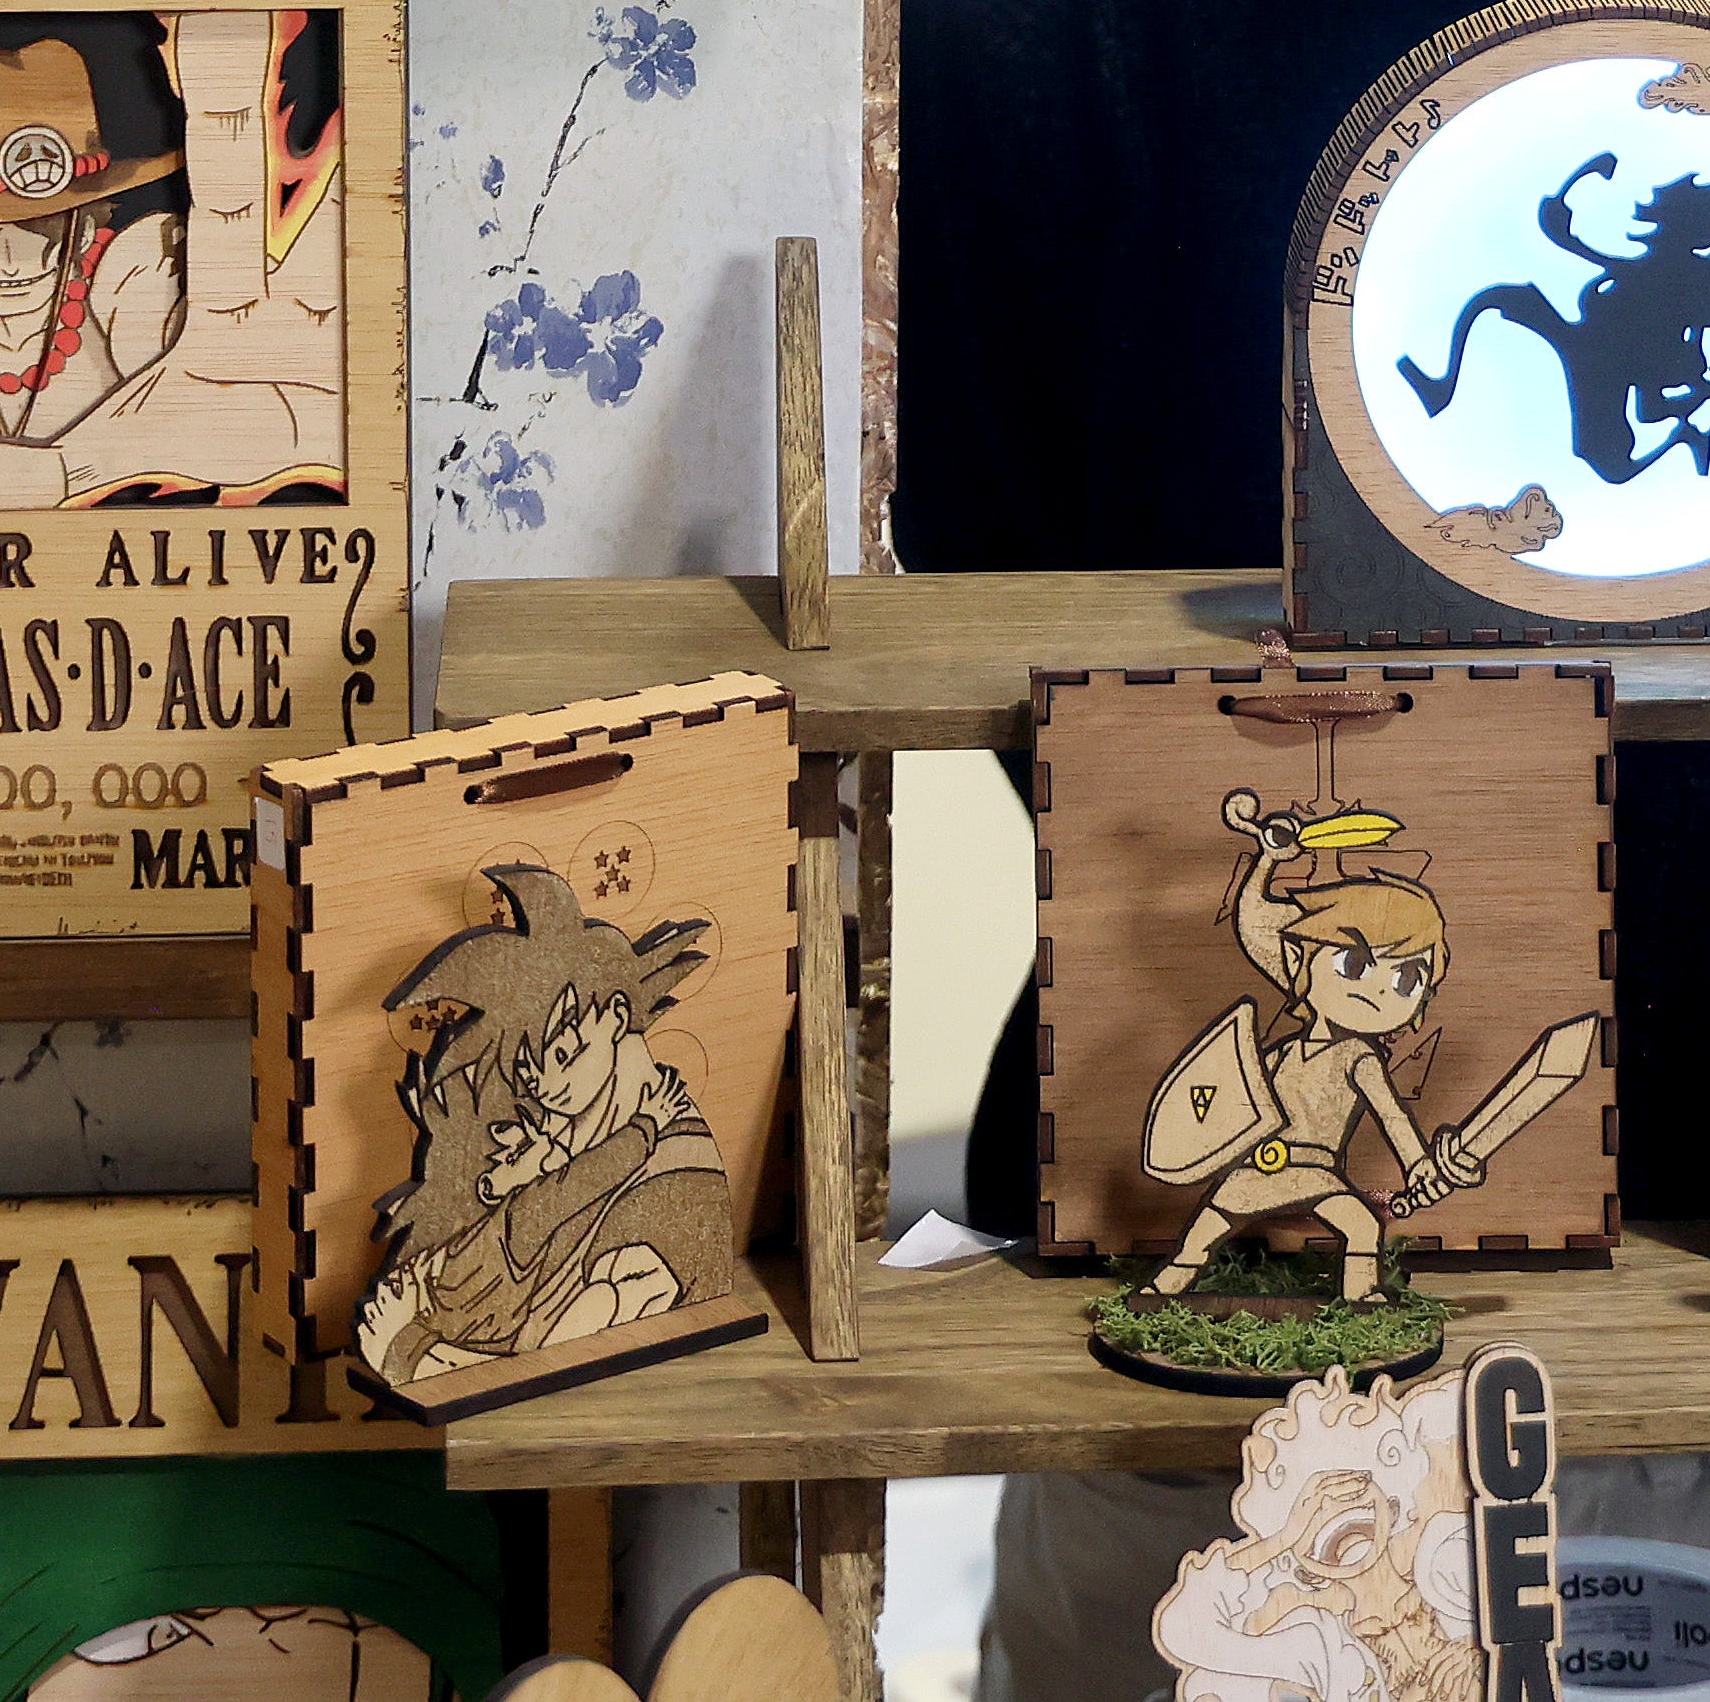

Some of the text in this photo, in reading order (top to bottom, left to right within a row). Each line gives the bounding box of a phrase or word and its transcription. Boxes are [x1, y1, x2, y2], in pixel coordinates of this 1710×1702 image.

[95, 526, 339, 590] ALIVE
[129, 826, 253, 892] MAR
[1559, 1573, 1644, 1601] nesp
